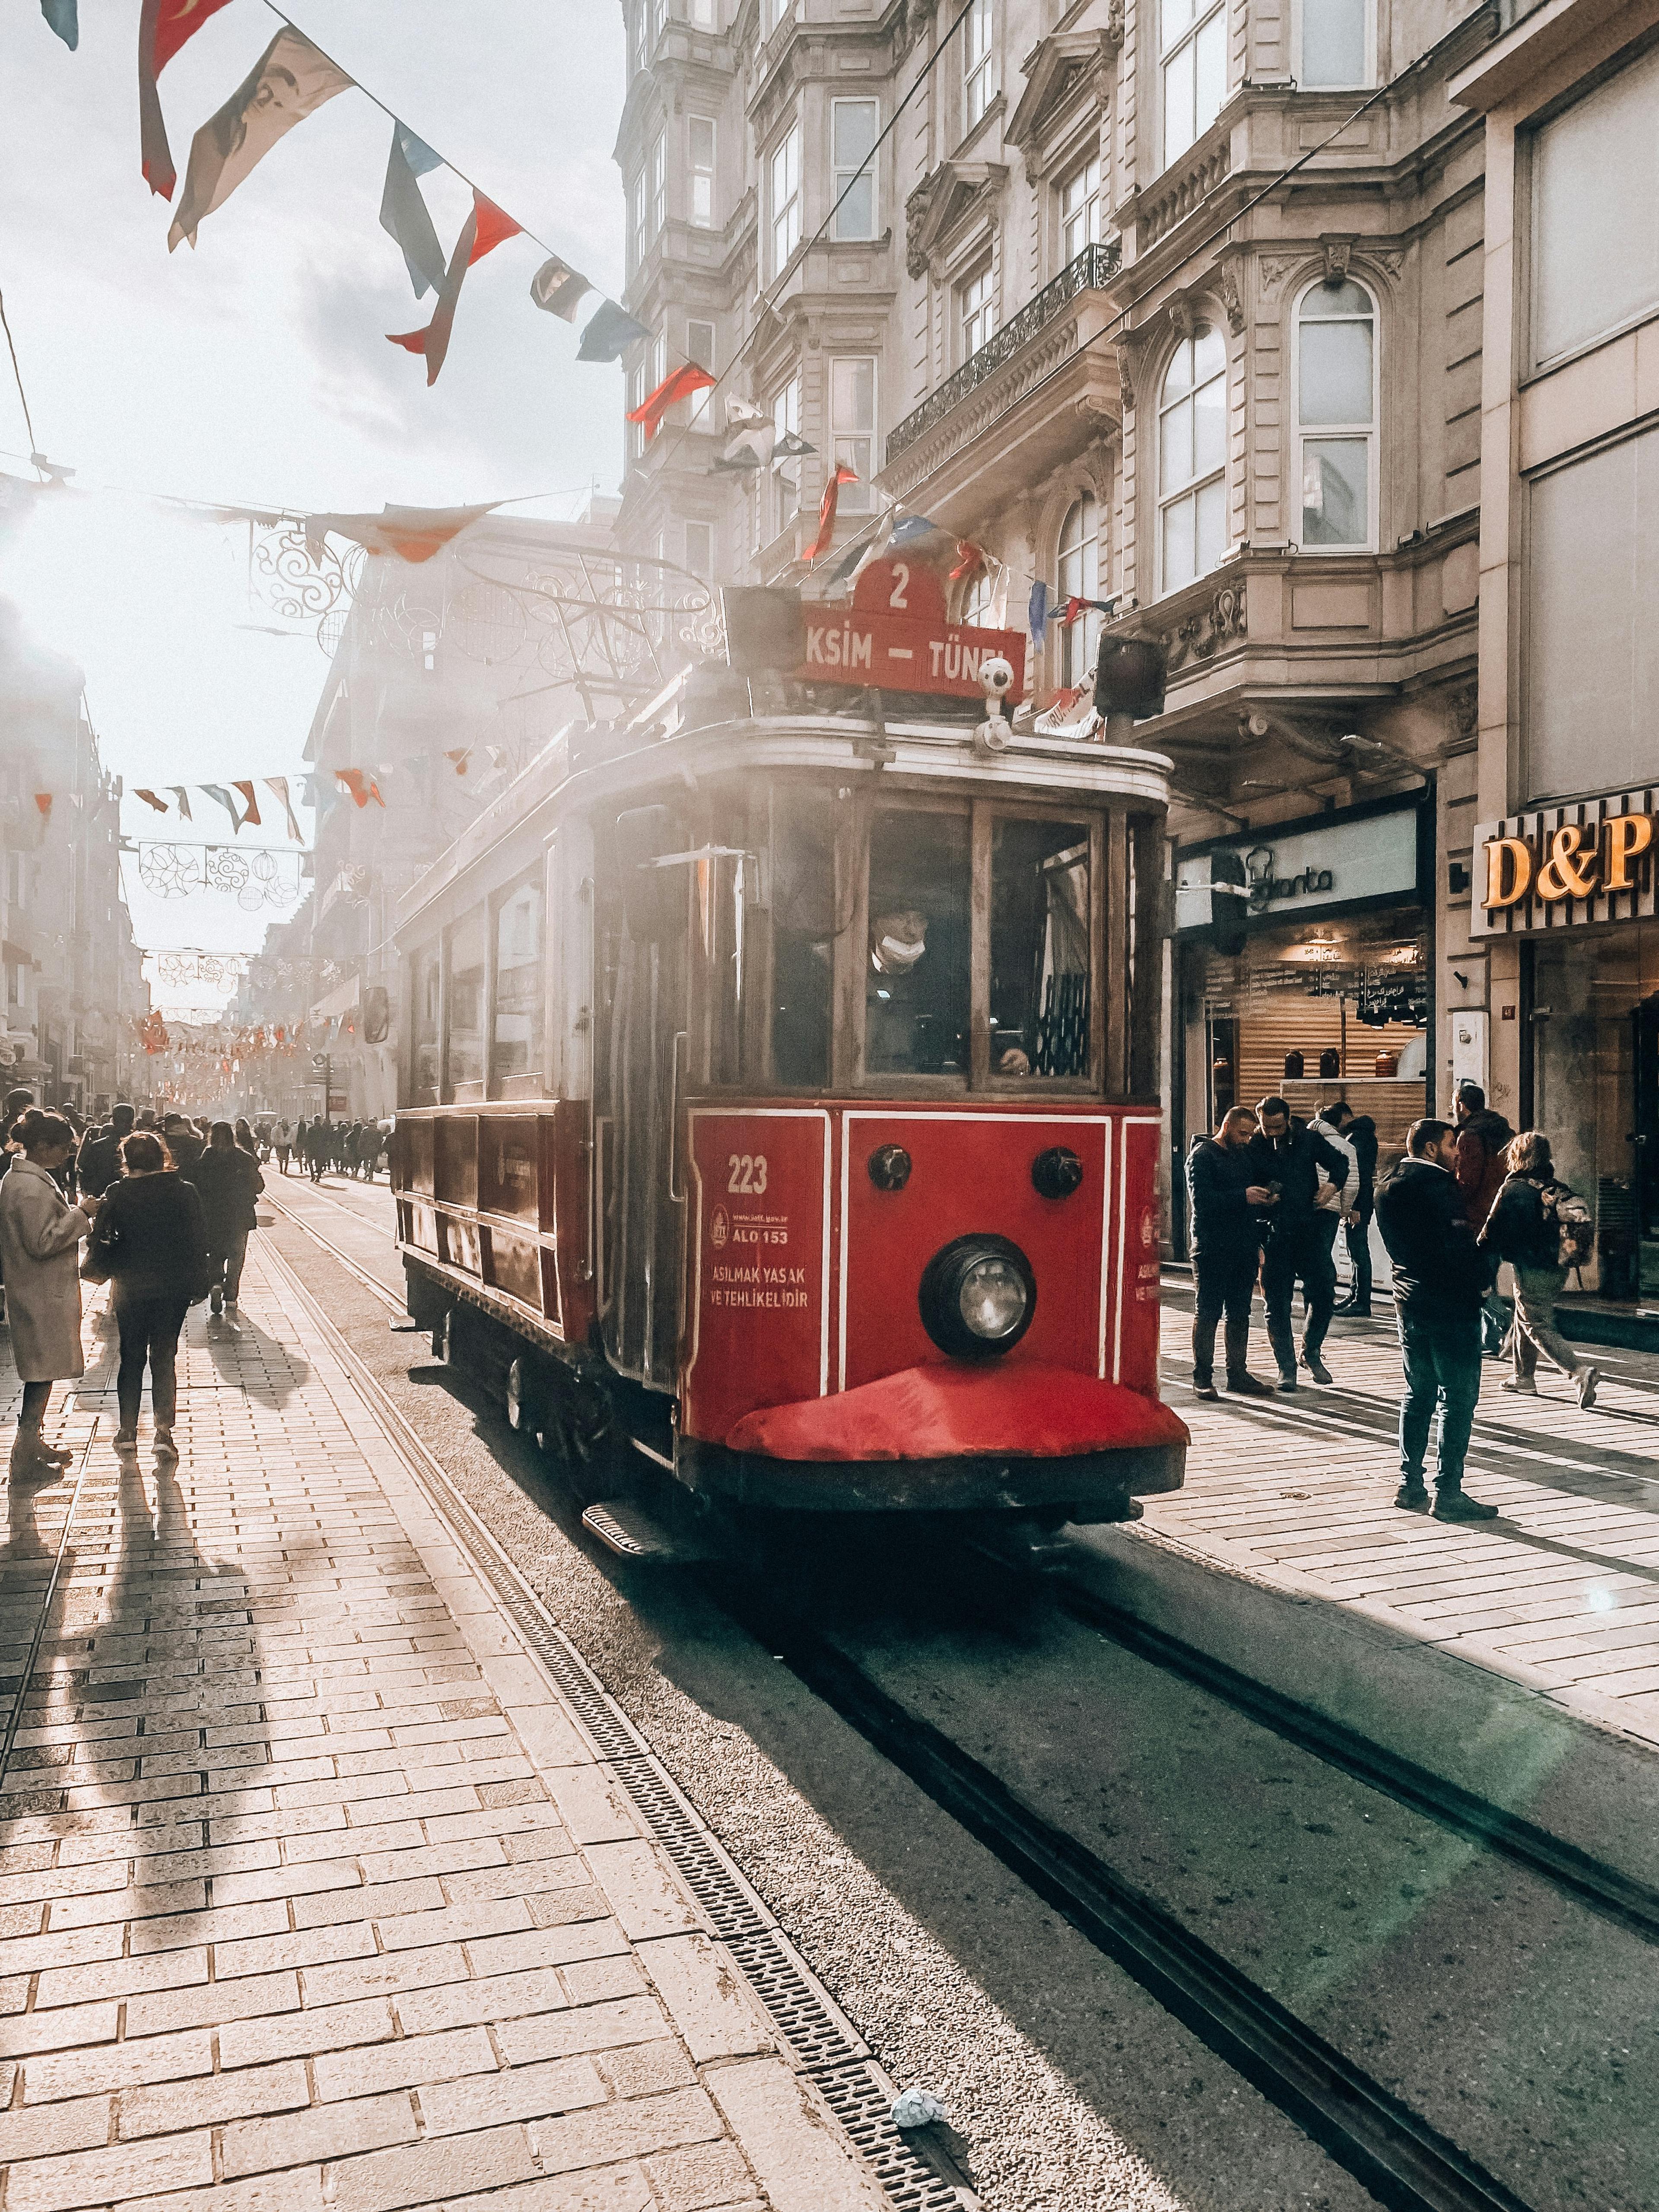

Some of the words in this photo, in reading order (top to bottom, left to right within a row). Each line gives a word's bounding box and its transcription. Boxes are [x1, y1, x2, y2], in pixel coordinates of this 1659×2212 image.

[890, 563, 909, 609] 2
[929, 633, 1004, 682] TÜN
[1481, 813, 1653, 909] D&P
[728, 1154, 767, 1194] 223
[733, 1229, 758, 1243] ALO
[763, 1231, 788, 1244] 153
[713, 1266, 760, 1283] ASILMAK
[763, 1267, 805, 1283] YASAK
[712, 1290, 722, 1306] VE
